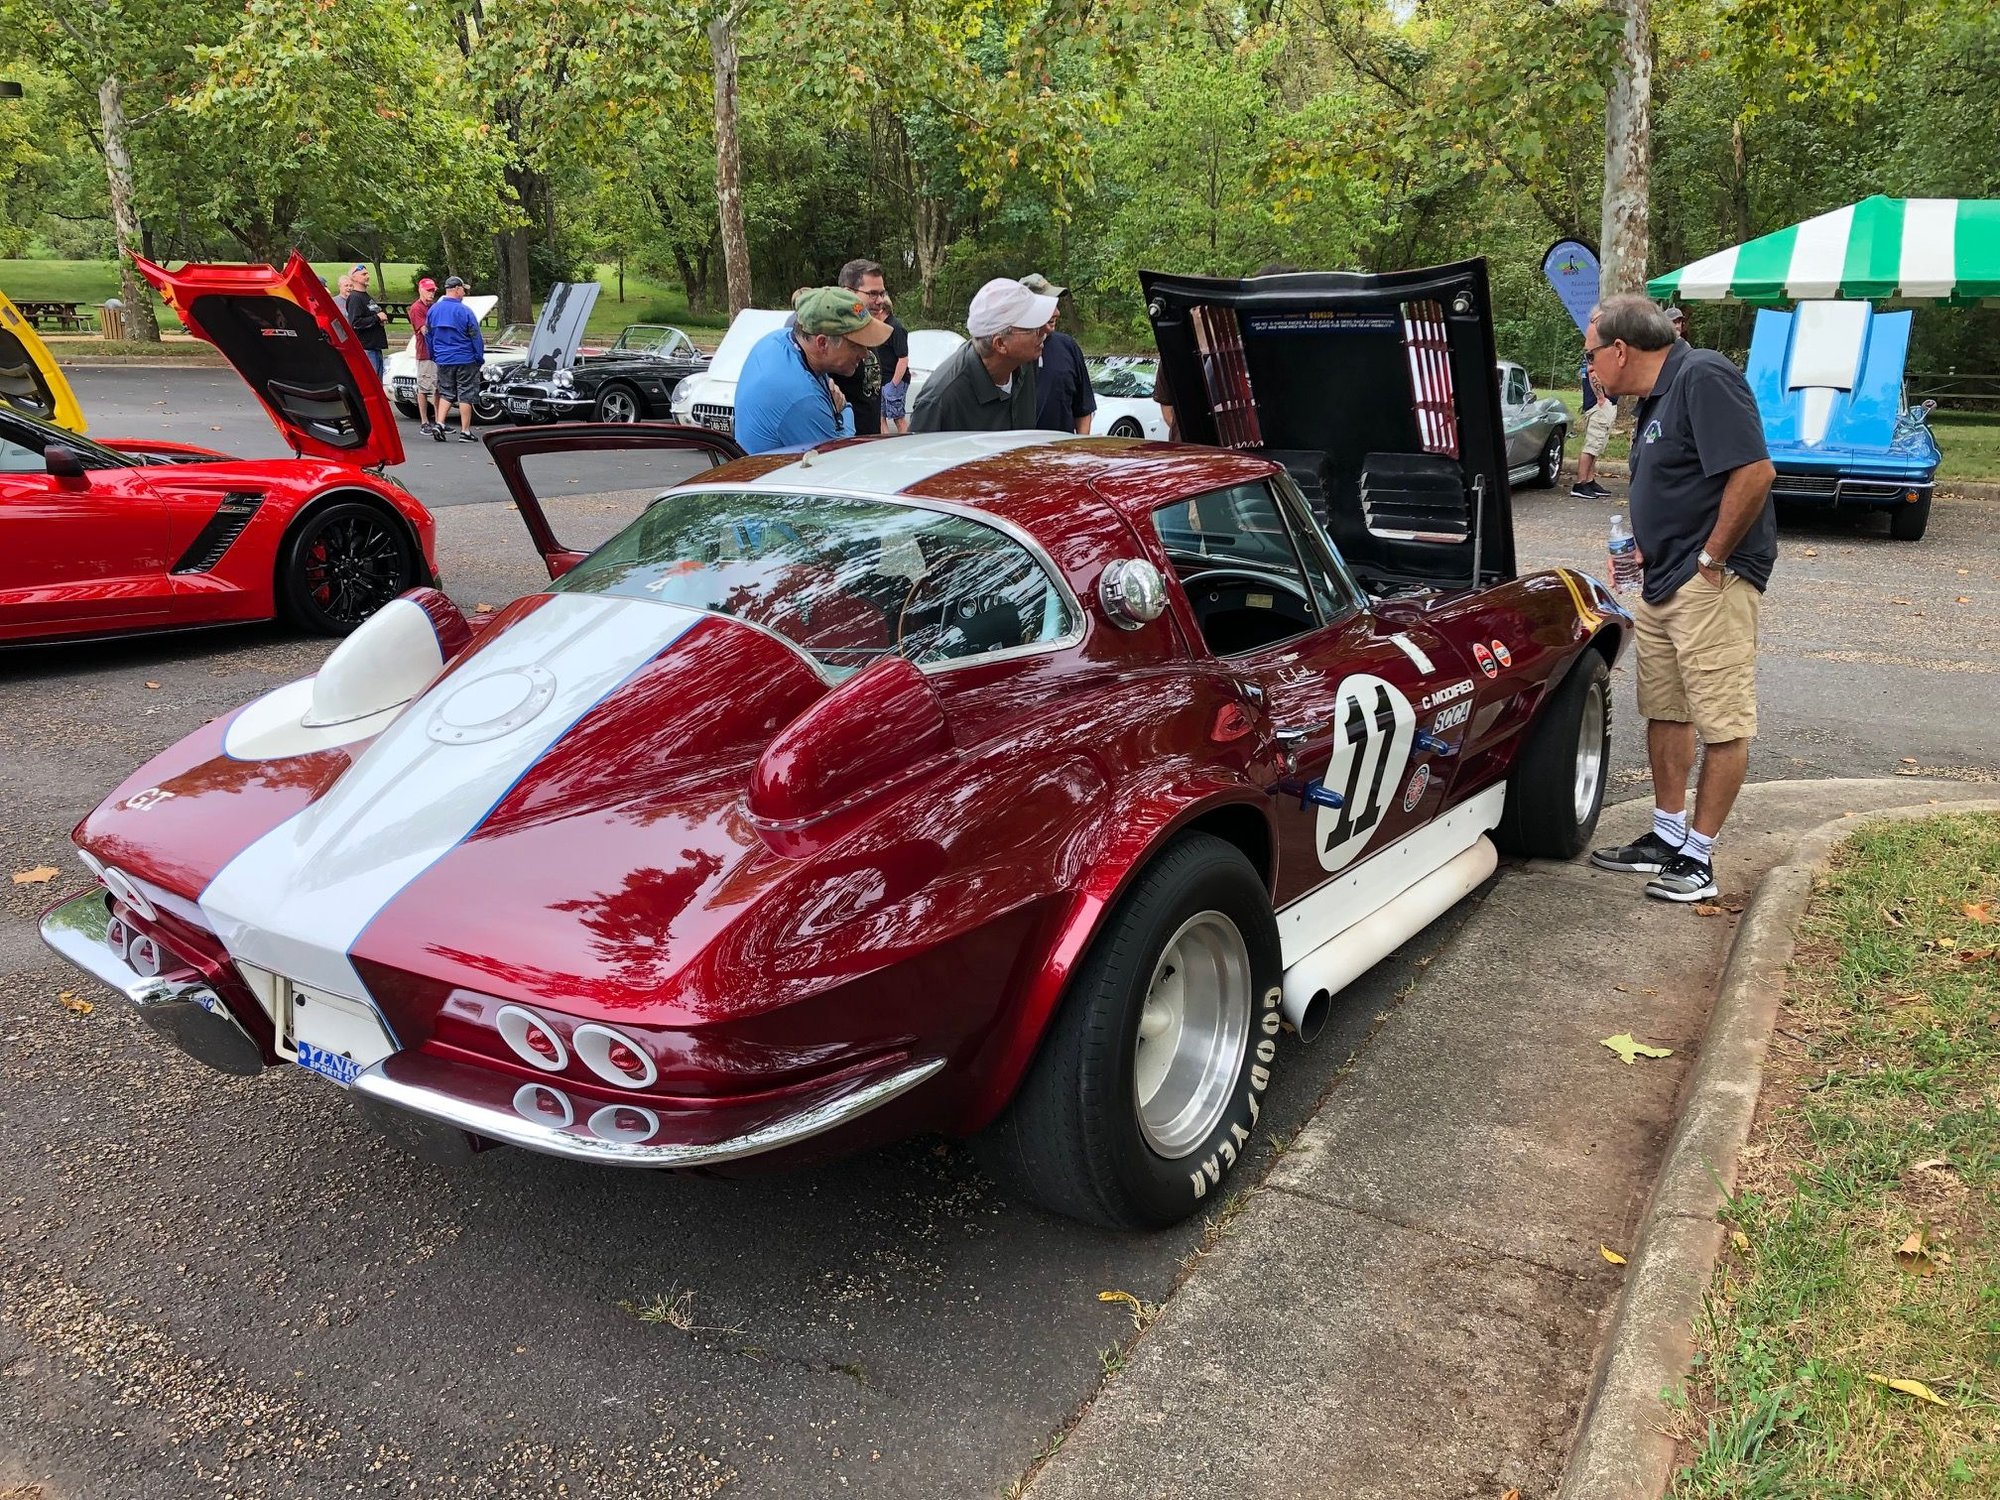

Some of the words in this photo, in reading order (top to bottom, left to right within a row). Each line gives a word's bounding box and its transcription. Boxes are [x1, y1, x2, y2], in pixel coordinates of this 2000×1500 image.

[261, 328, 298, 337] Z06
[1421, 695, 1432, 710] C
[1431, 679, 1475, 706] MODIFIED
[1435, 701, 1470, 733] SCCA
[1324, 684, 1397, 854] 11
[125, 787, 177, 811] GT
[309, 1060, 343, 1080] SPORTS
